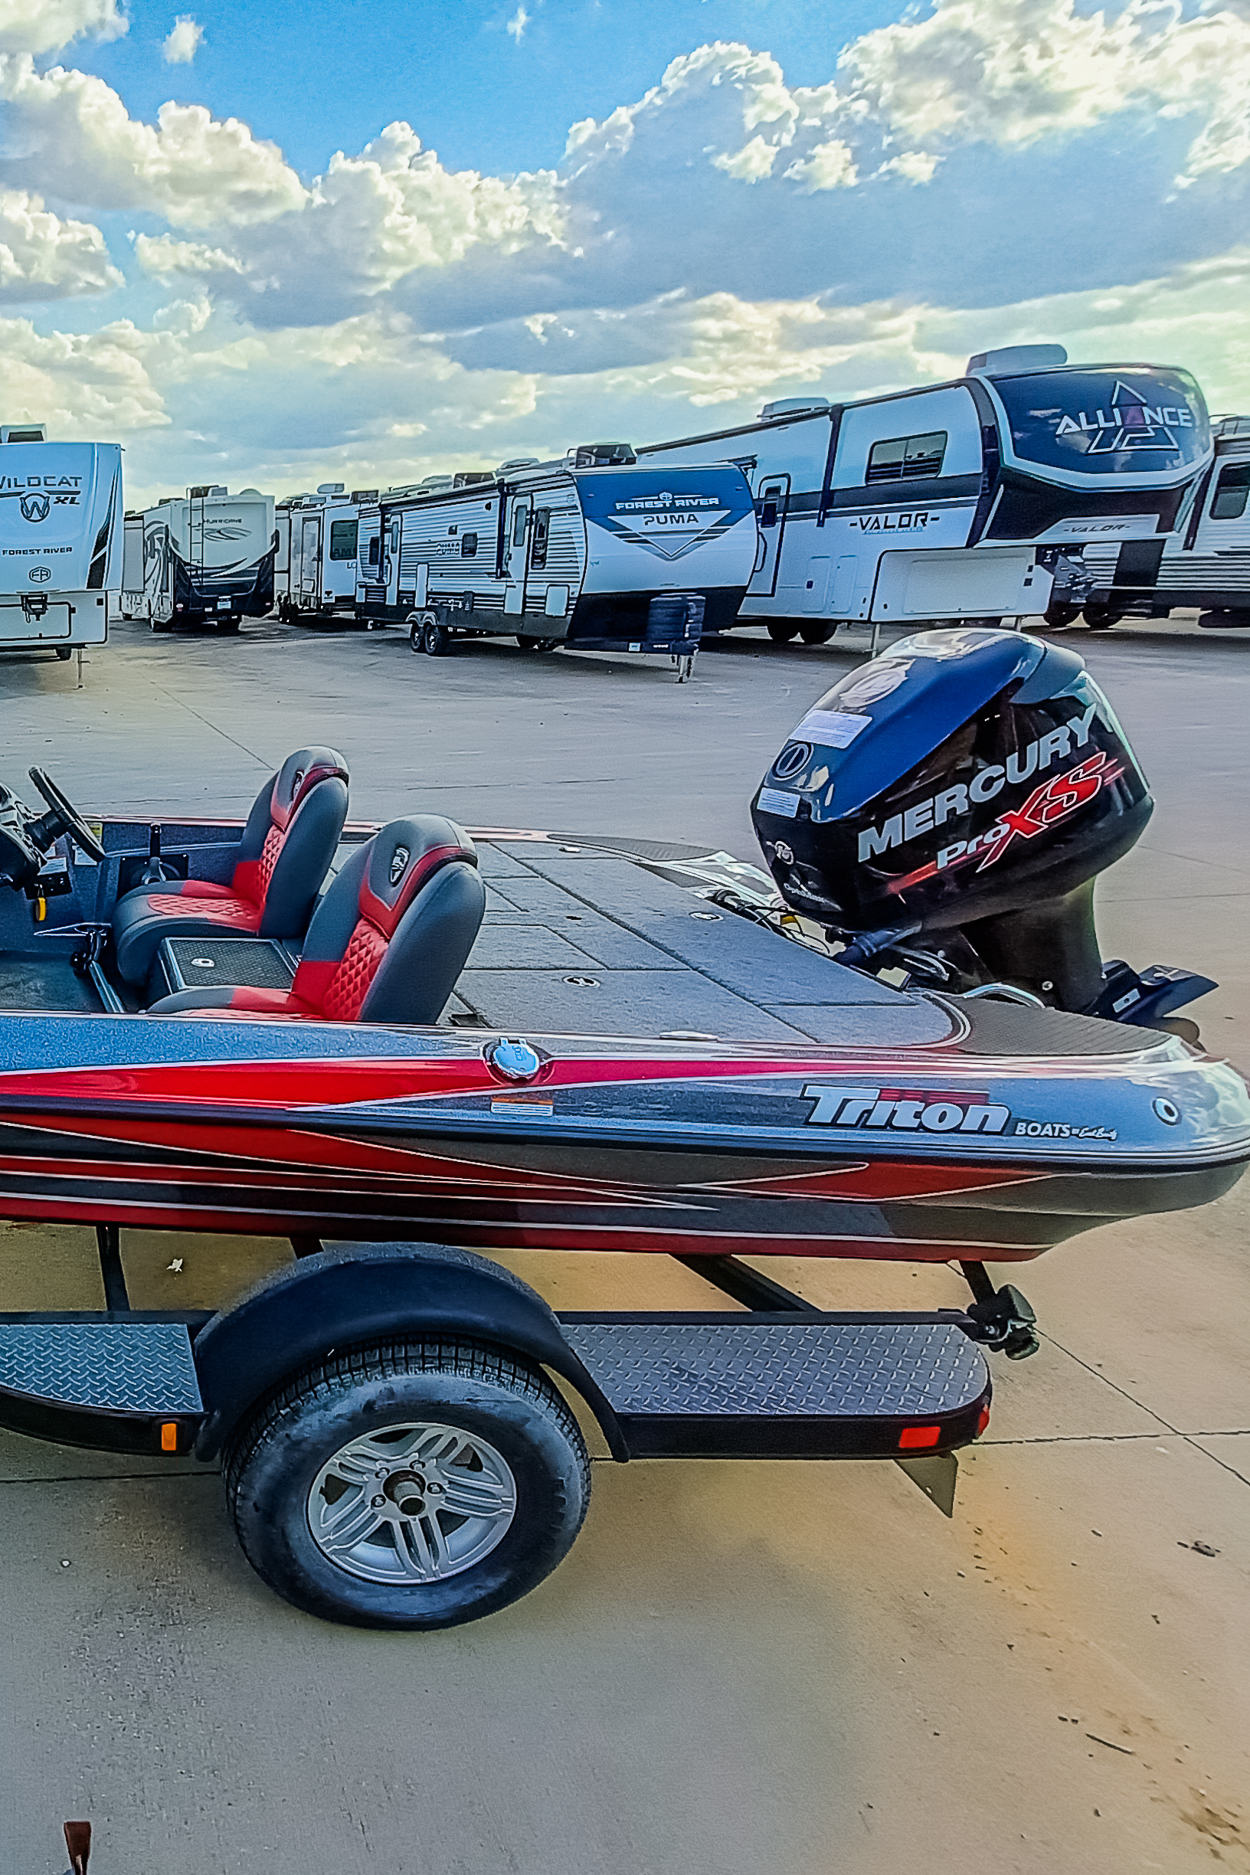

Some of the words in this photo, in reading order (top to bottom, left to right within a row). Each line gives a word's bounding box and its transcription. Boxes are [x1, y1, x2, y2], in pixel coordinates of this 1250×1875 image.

[1054, 405, 1194, 436] ALLIANCE
[52, 496, 80, 505] XL
[615, 501, 672, 510] FOREST
[675, 497, 720, 507] RIVER
[643, 513, 699, 525] PUMA
[43, 546, 73, 554] RIVER
[857, 702, 1097, 863] MERCURY
[801, 1084, 1010, 1133] Triton
[1014, 1121, 1071, 1138] BOATS
